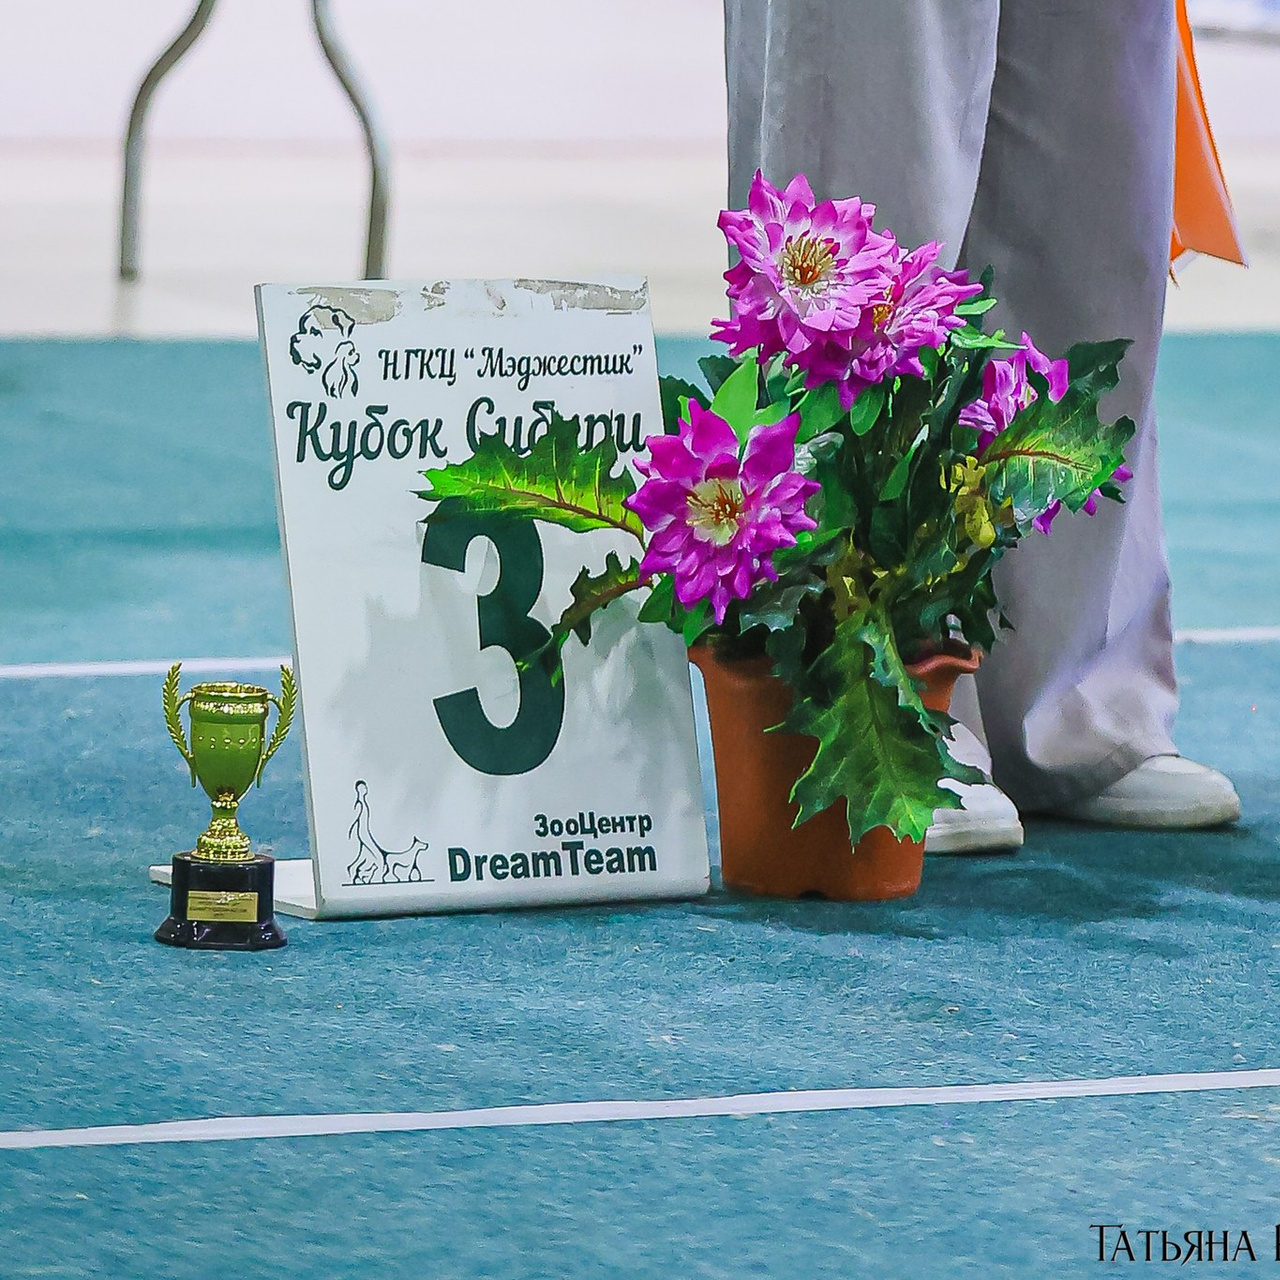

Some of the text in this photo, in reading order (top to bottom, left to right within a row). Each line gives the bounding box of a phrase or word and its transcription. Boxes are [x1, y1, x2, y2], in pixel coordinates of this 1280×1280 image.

[378, 347, 457, 387] НГКЦ
[286, 400, 449, 491] Кубок
[421, 495, 565, 776] 3
[534, 811, 653, 839] ЗооЦентр
[448, 840, 658, 882] DreamTeam
